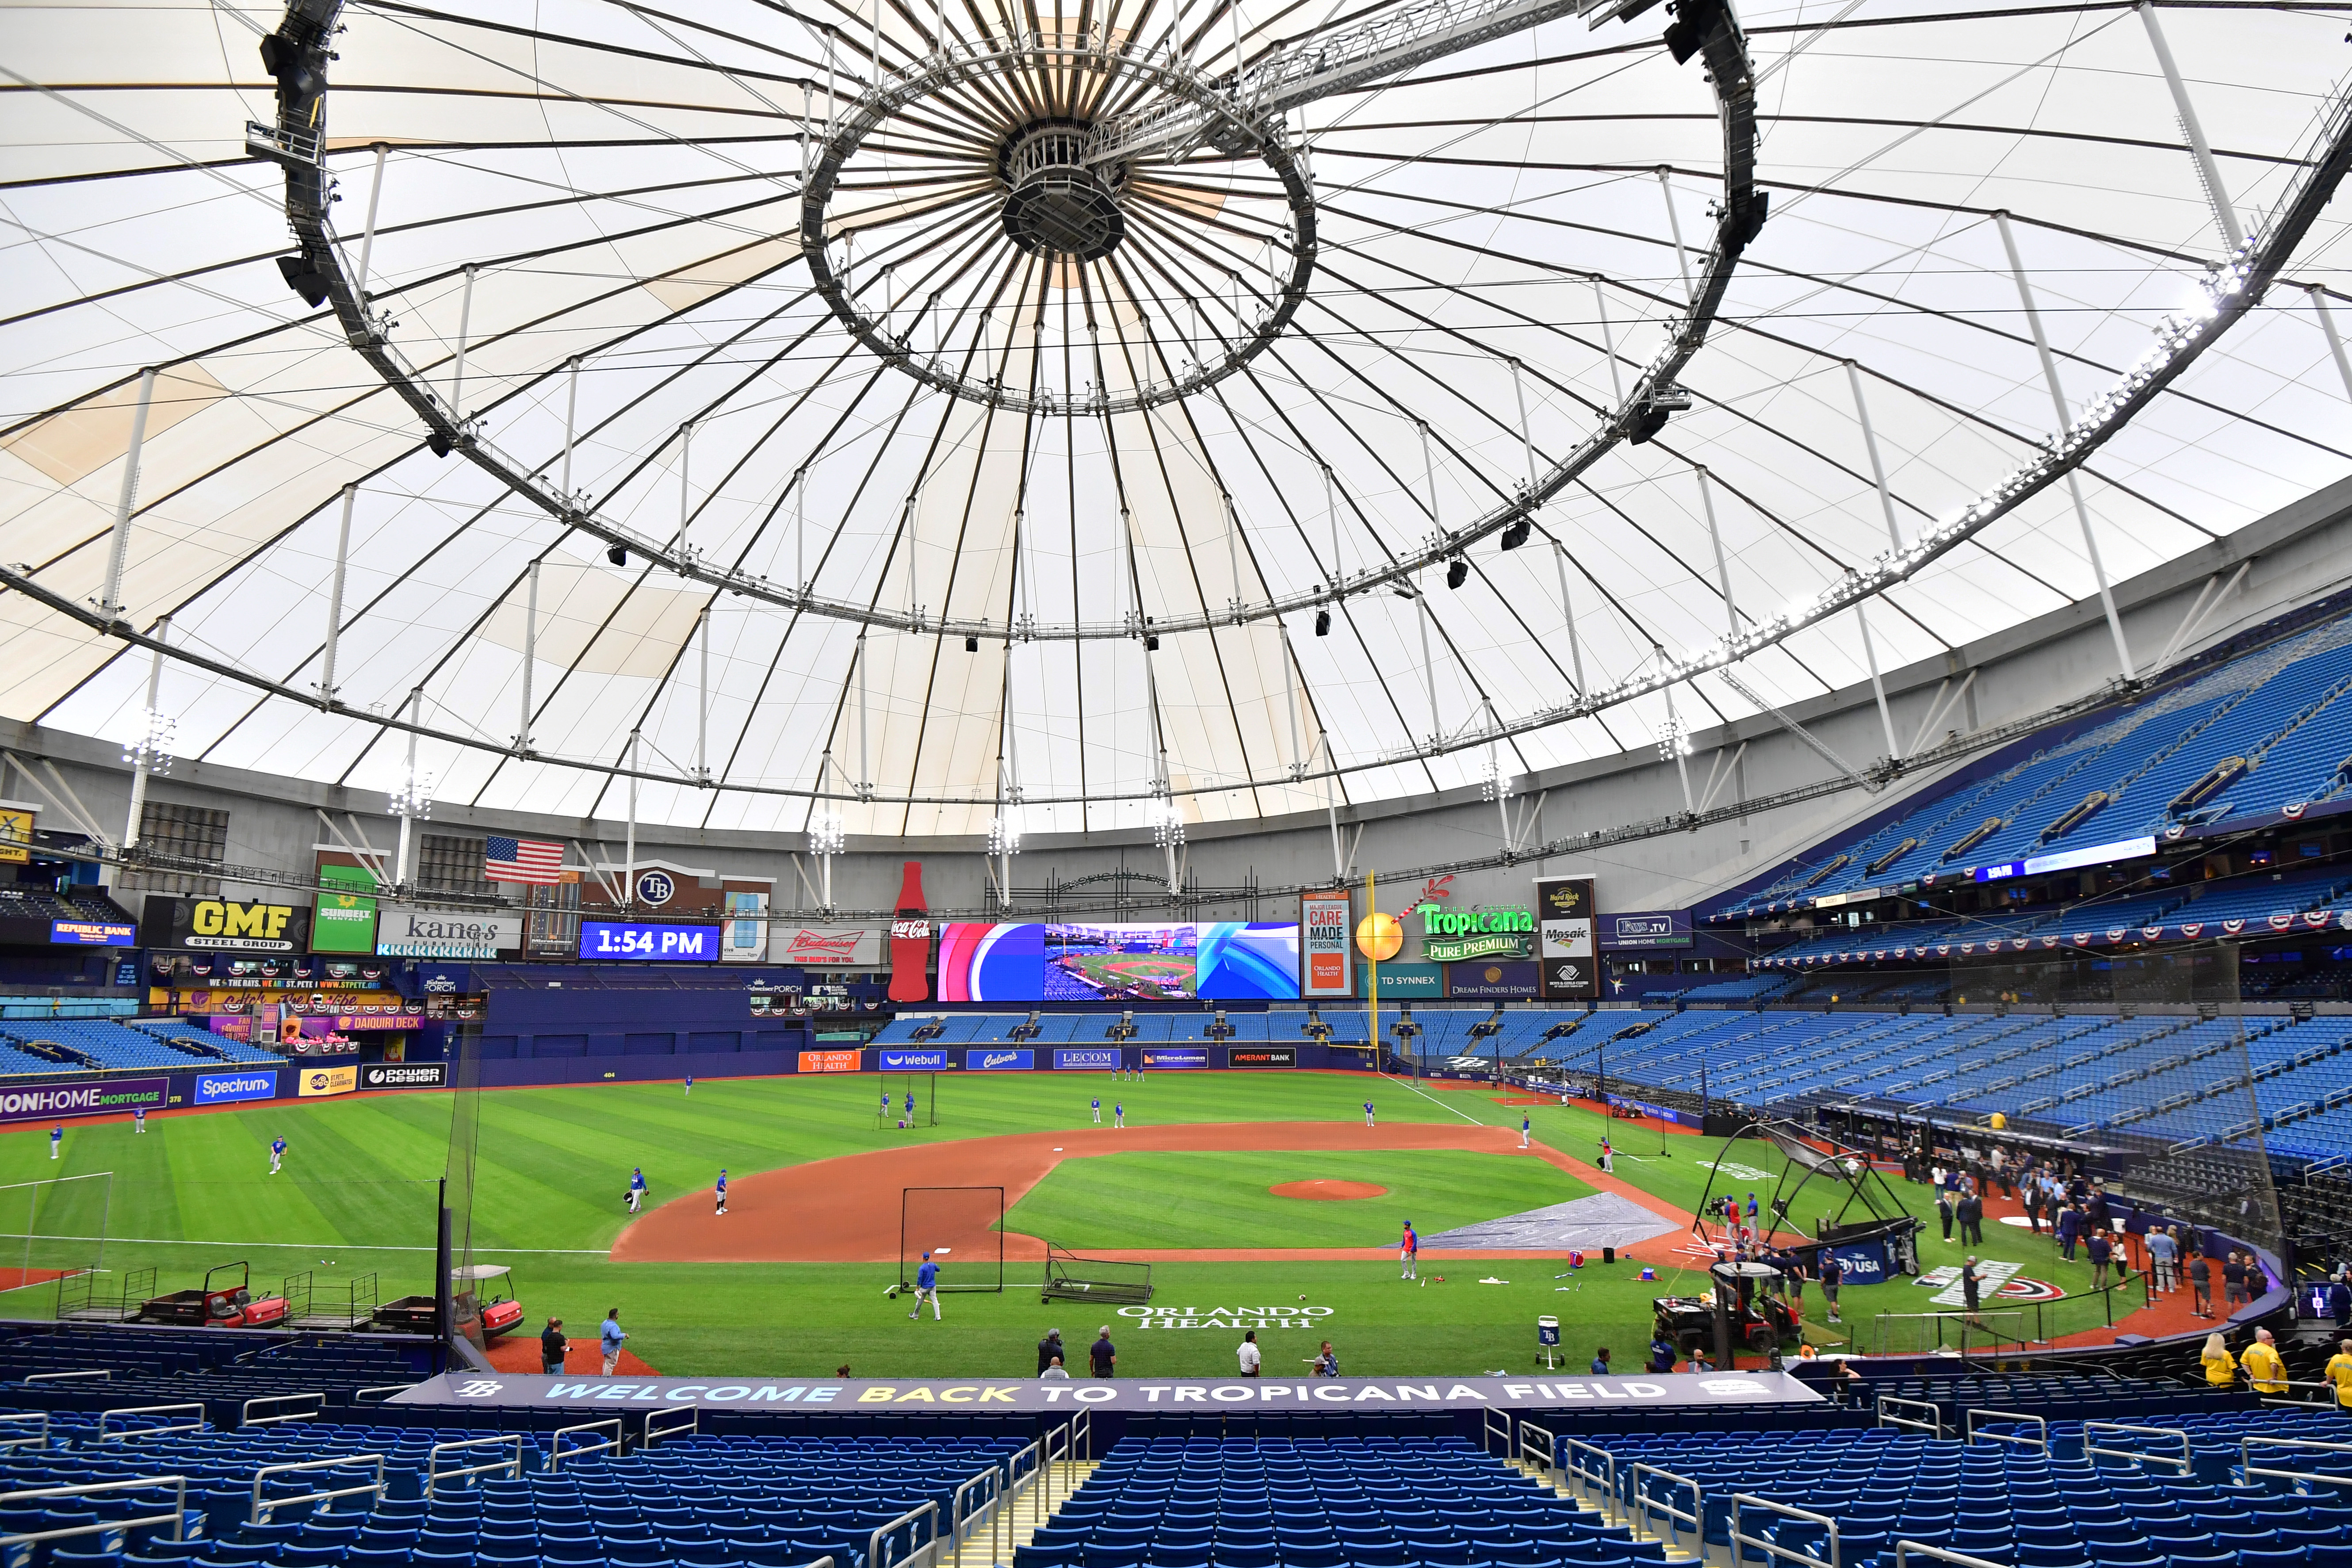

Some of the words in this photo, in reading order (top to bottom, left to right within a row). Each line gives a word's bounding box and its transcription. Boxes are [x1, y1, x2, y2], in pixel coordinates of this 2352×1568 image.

[644, 877, 669, 899] TB
[193, 901, 292, 938] GMF
[321, 908, 371, 918] SUNBELT
[1310, 911, 1342, 926] CARE
[405, 914, 498, 941] kane's
[1417, 904, 1534, 937] Tropicana
[56, 923, 103, 934] REPUBLIC
[104, 926, 132, 936] BANK
[891, 920, 930, 938] Coca-Cola
[1310, 927, 1343, 940] MADE
[1546, 927, 1587, 939] Mosaic
[194, 938, 237, 948] STEEL
[242, 940, 287, 949] GROUP
[597, 930, 654, 952] 1:54
[662, 932, 703, 953] PM
[795, 934, 857, 948] Budweiser
[1430, 945, 1461, 957] PURE
[1463, 937, 1519, 955] PREMIUM
[225, 991, 267, 1004] Catch
[327, 993, 359, 1005] Vibe
[354, 1017, 394, 1029] DAIQUIRI
[396, 1017, 419, 1028] DECK
[905, 1055, 940, 1065] Webull
[983, 1051, 1017, 1068] Culver's
[203, 1078, 266, 1097] Spectrum
[330, 1078, 352, 1087] CLEARWATER
[1855, 1260, 1880, 1273] USA
[1117, 1306, 1334, 1317] ORLANDO
[1137, 1318, 1315, 1329] HEALTH
[1543, 1330, 1555, 1342] TB
[456, 1380, 503, 1397] TB
[545, 1384, 839, 1402] WELCOME
[857, 1385, 1020, 1402] BACK
[1040, 1385, 1117, 1402] TO
[1139, 1384, 1488, 1401] TROPICANA
[1503, 1383, 1666, 1399] FIELD
